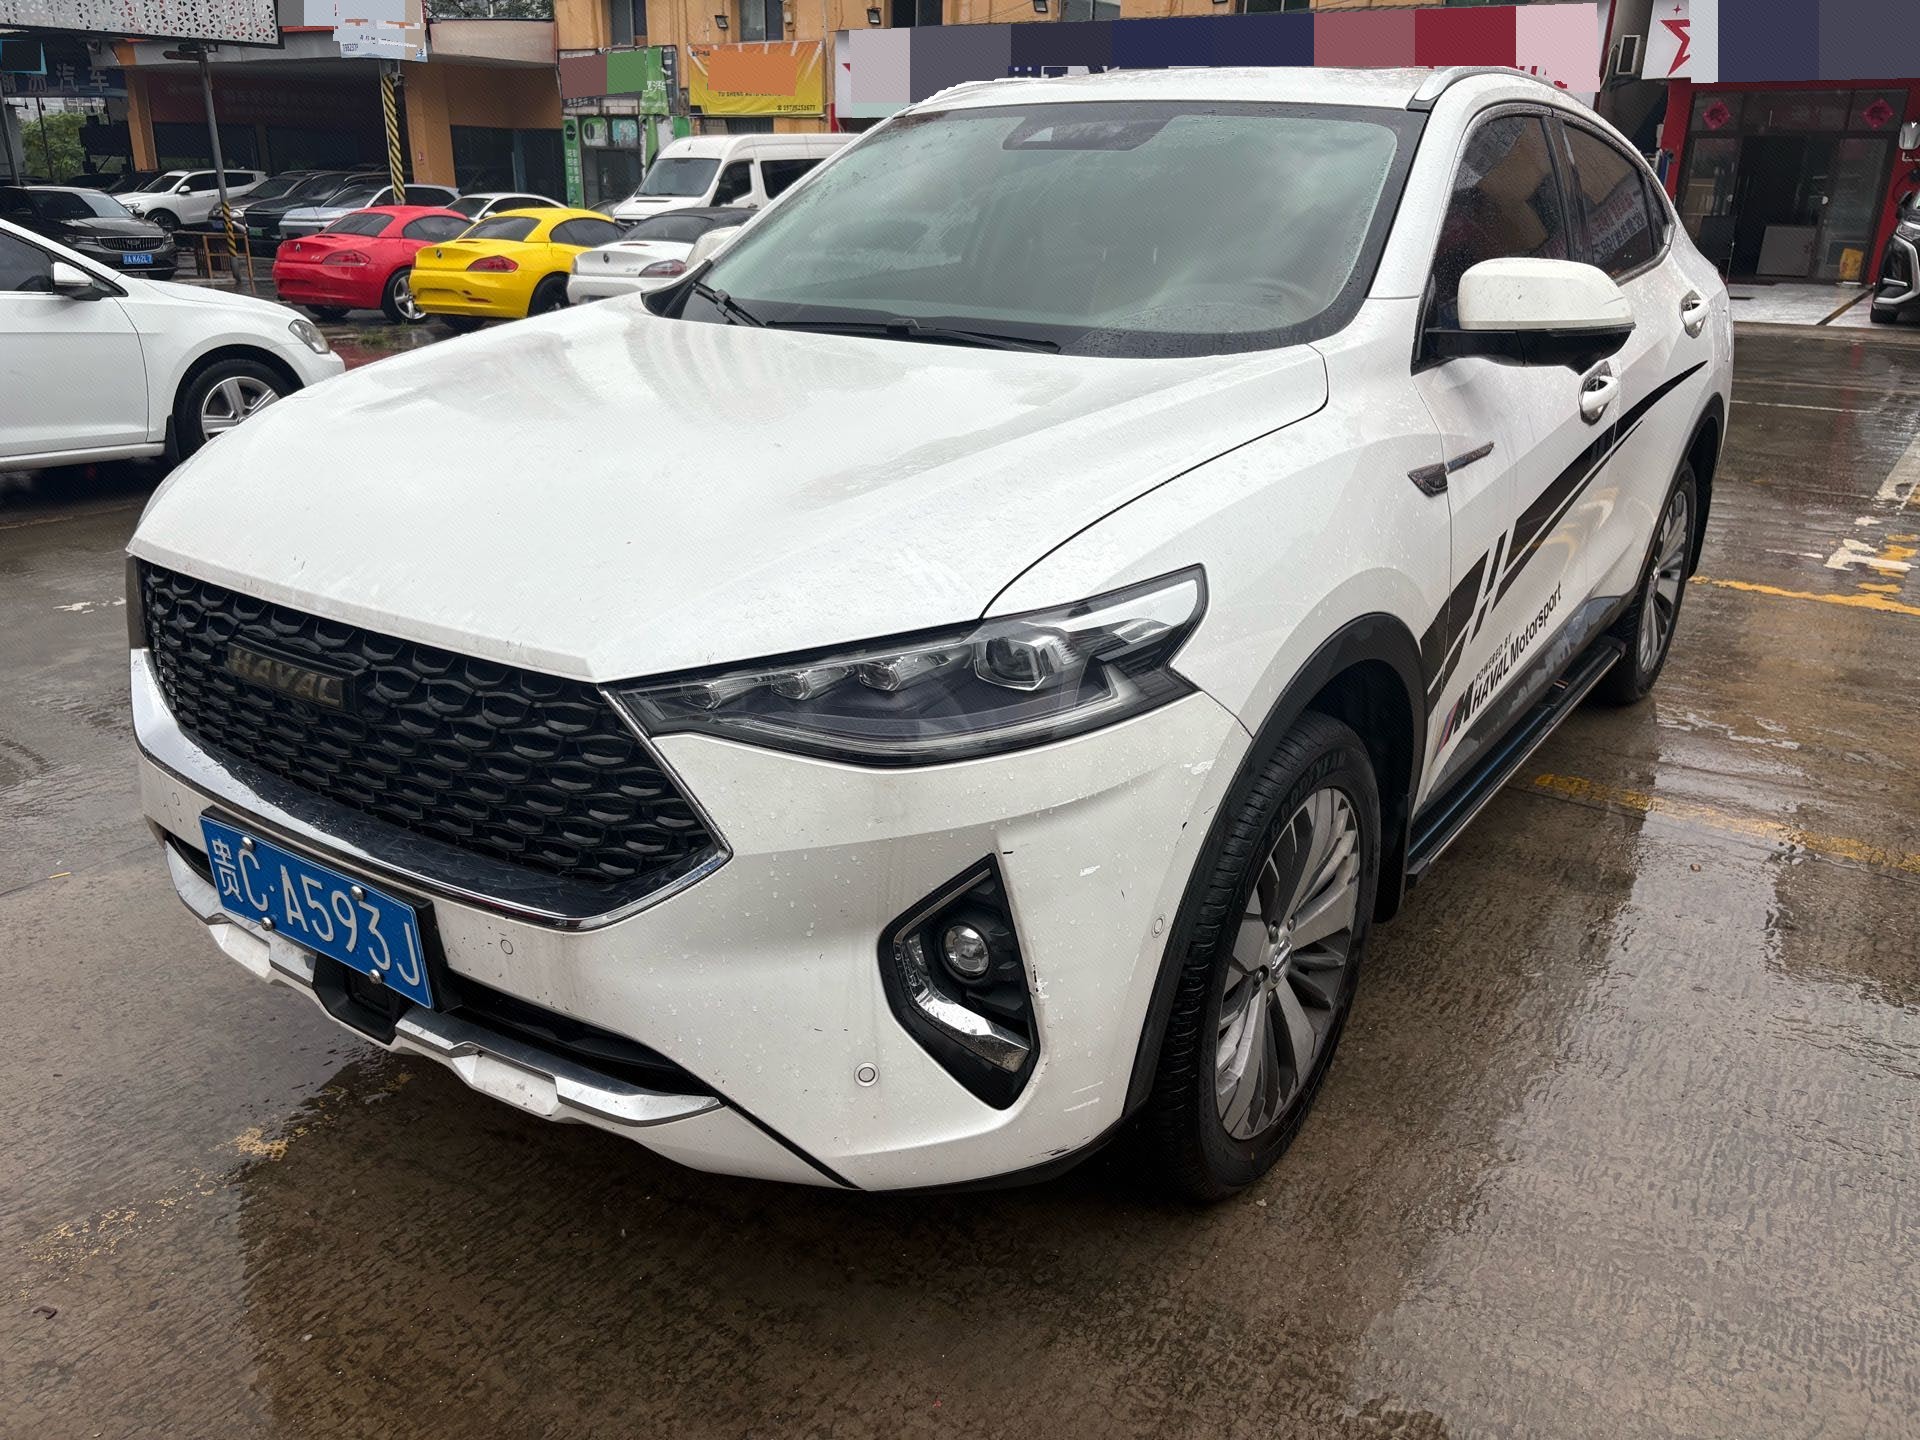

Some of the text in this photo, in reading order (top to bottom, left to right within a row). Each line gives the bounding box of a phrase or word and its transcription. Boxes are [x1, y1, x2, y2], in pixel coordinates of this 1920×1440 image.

[1471, 652, 1510, 715] HAVAL
[1510, 580, 1562, 667] Motorsport
[1474, 643, 1503, 686] POWERED
